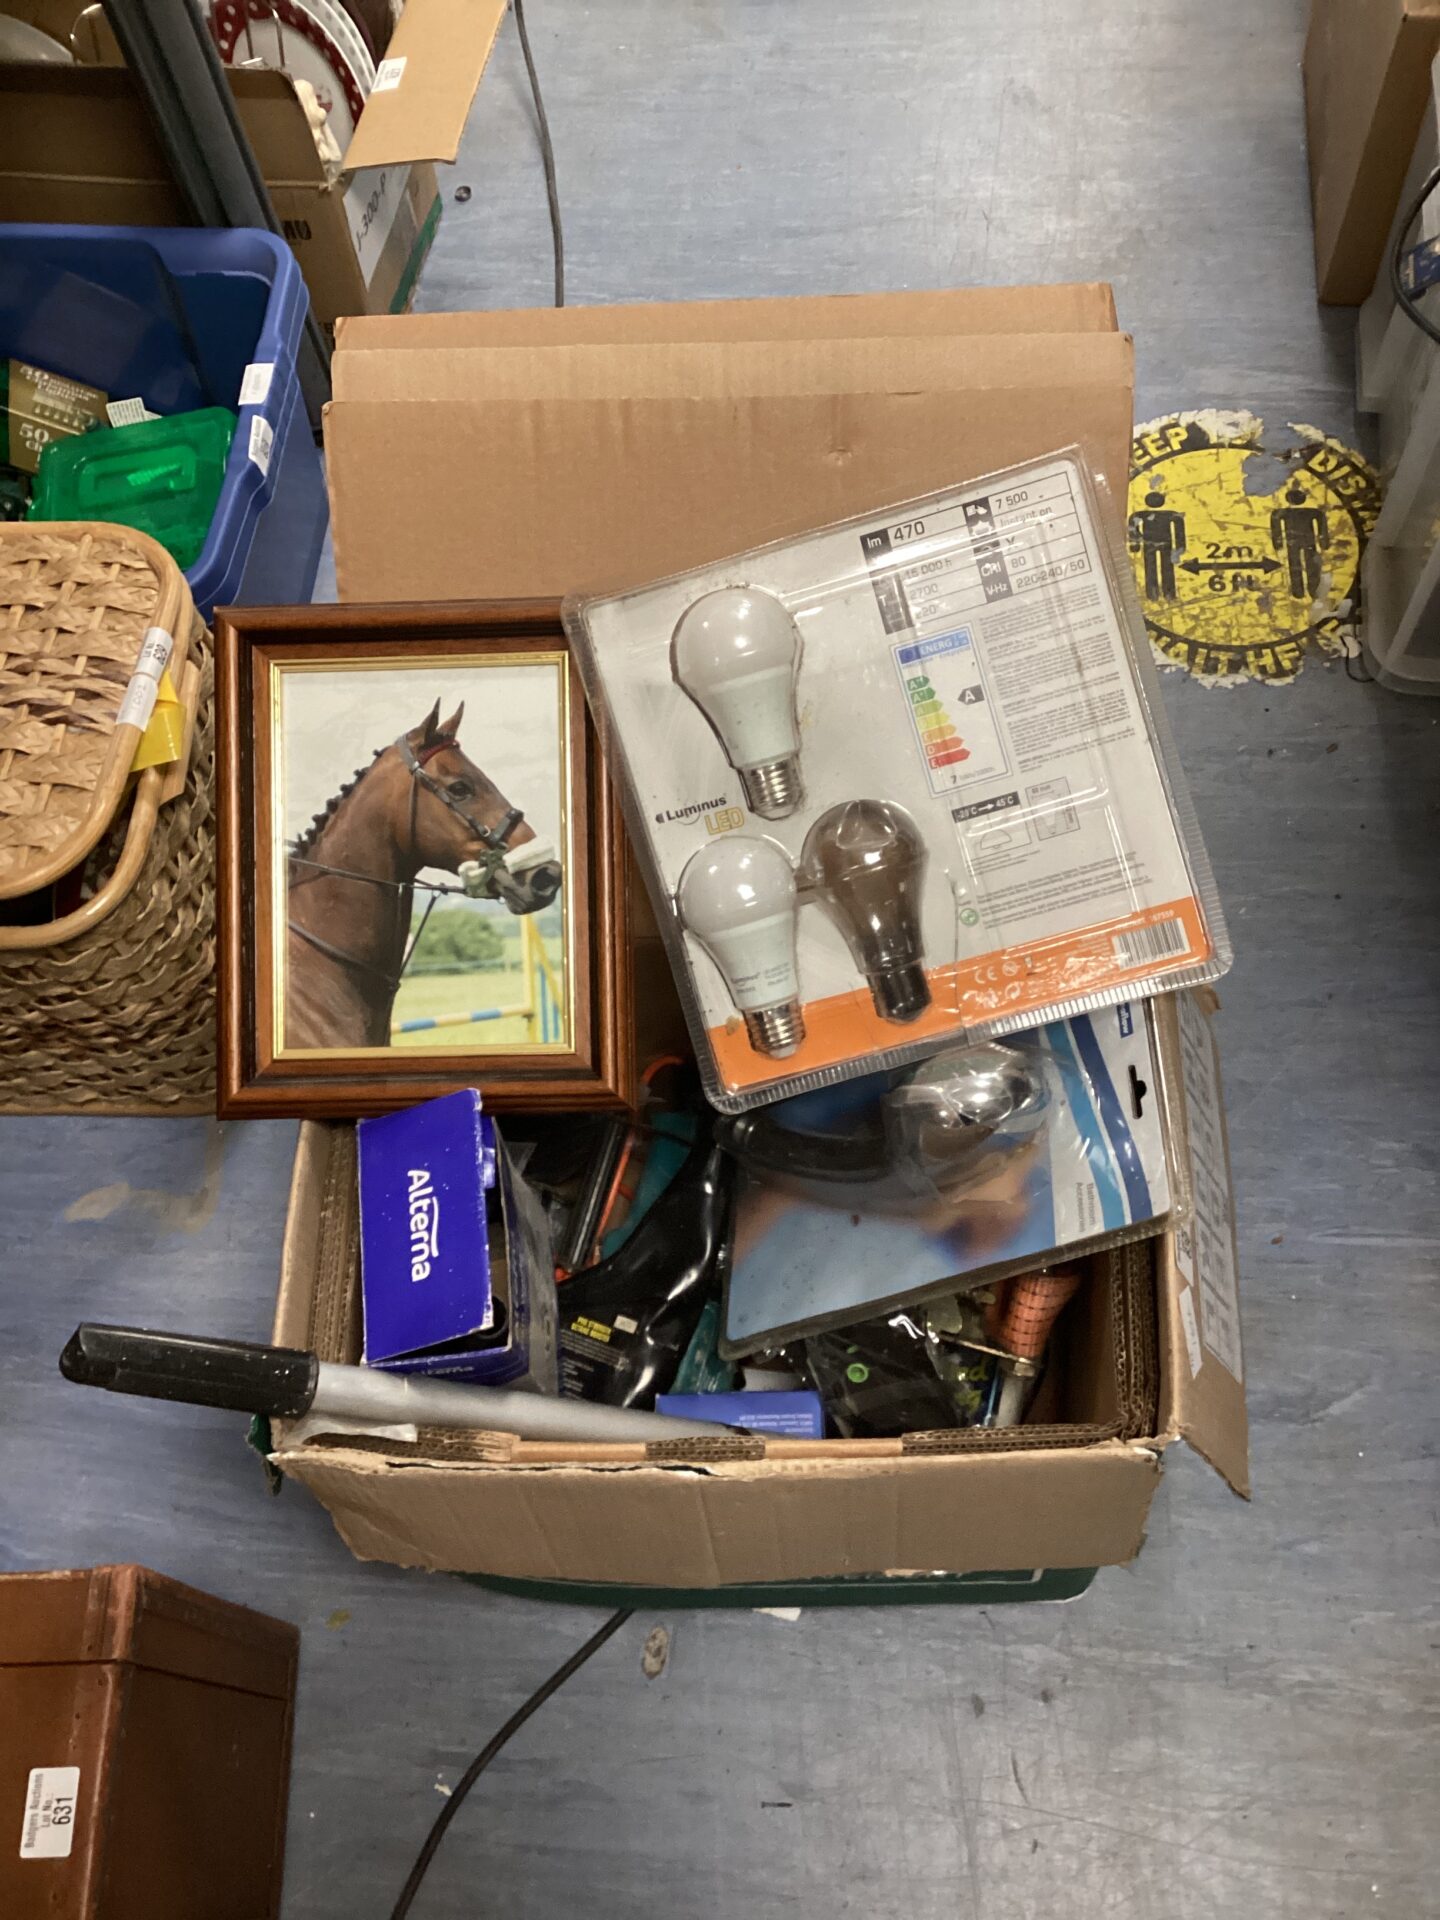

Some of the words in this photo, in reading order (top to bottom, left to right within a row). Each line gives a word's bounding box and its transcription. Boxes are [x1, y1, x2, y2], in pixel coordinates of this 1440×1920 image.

[1133, 426, 1188, 465] EEP
[1005, 490, 1029, 506] 500
[894, 520, 925, 541] 470
[1206, 543, 1254, 559] 2m
[1208, 574, 1226, 592] 6
[665, 796, 728, 822] Luminus
[704, 806, 745, 836] LED
[407, 1169, 434, 1282] Alterna
[52, 1797, 73, 1825] 631
